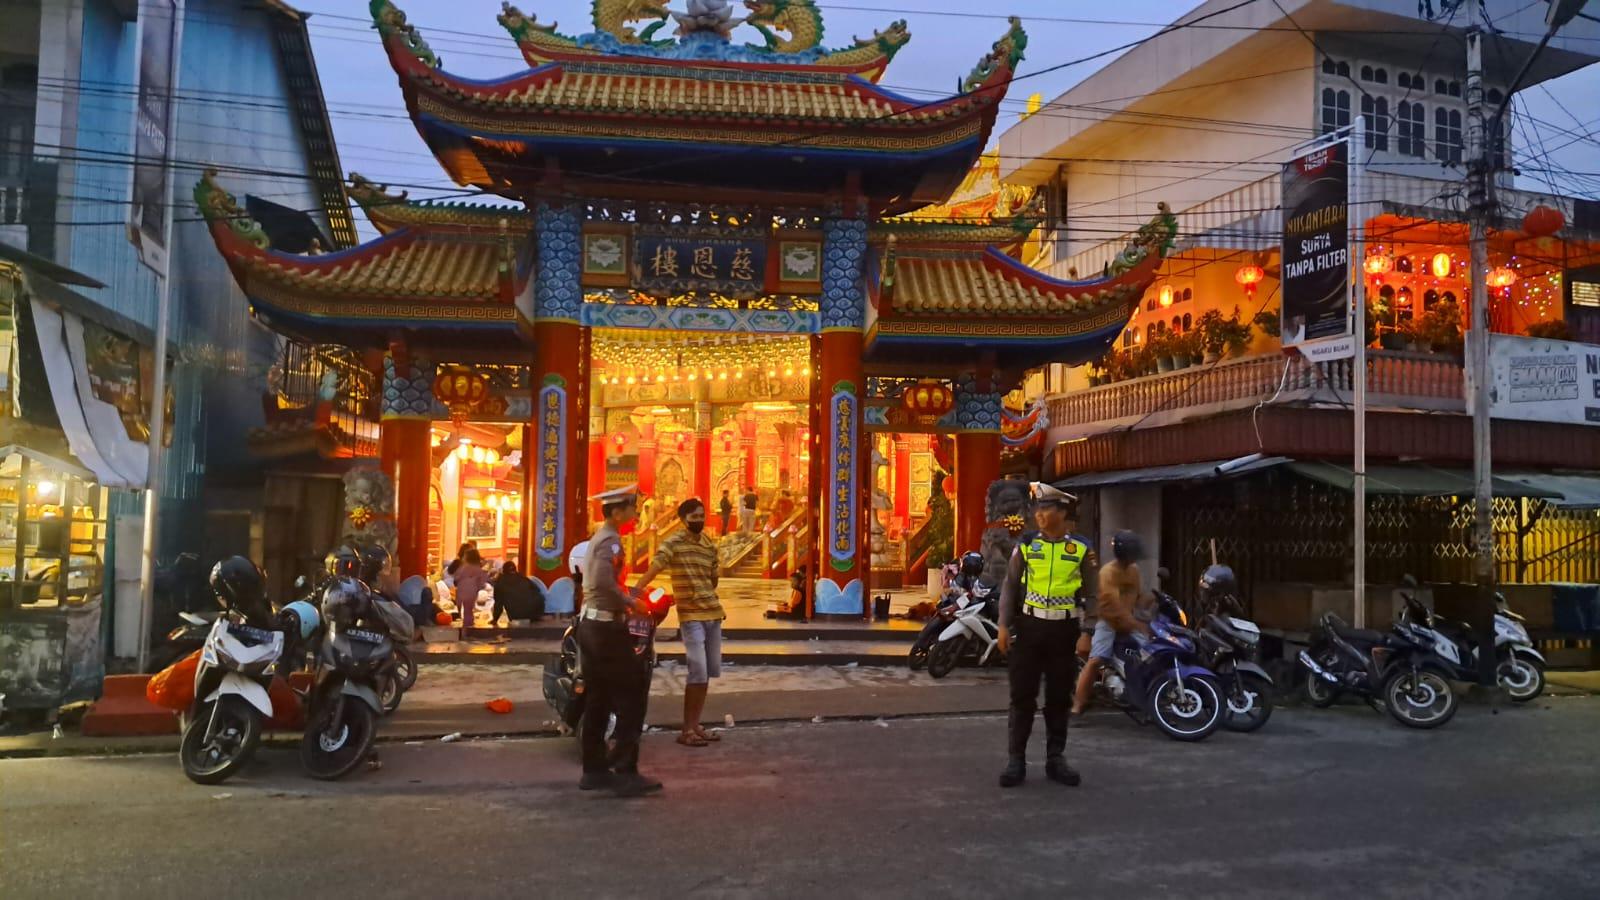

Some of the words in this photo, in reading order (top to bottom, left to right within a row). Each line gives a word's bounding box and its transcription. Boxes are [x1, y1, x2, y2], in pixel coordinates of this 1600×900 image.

[1301, 233, 1331, 255] SURYA
[1286, 260, 1315, 279] TANPA
[1317, 249, 1347, 272] FILTER
